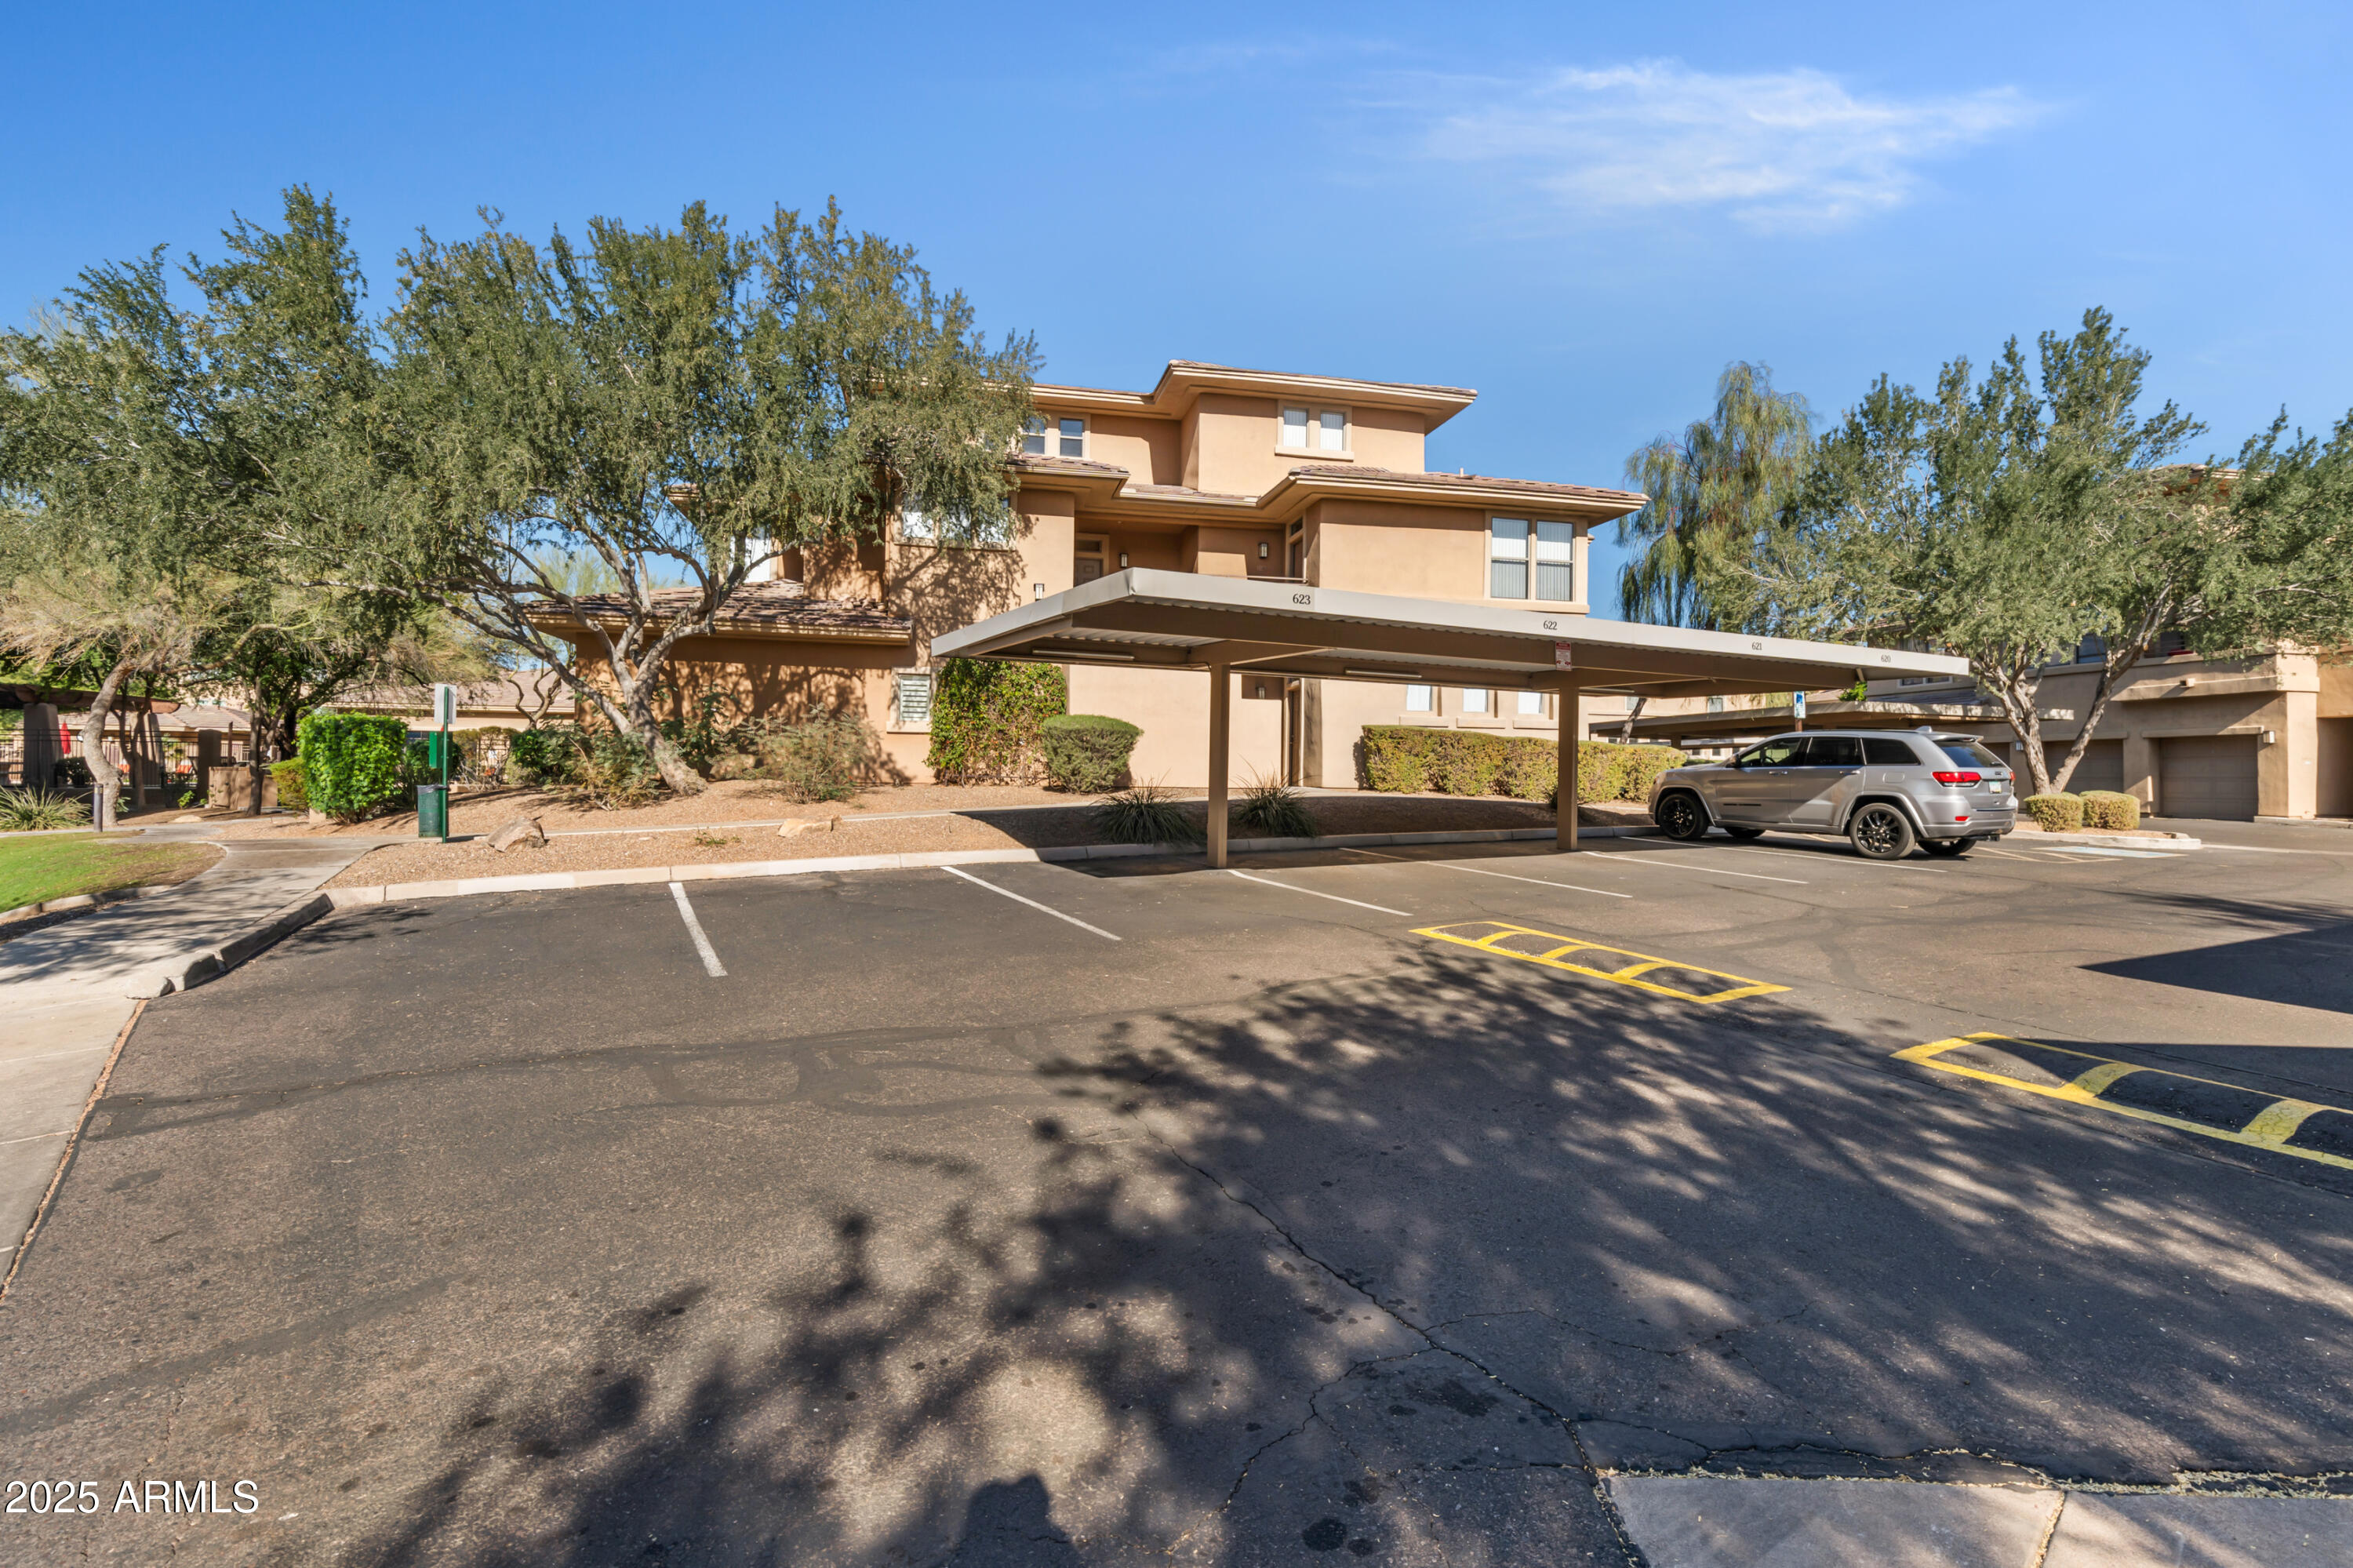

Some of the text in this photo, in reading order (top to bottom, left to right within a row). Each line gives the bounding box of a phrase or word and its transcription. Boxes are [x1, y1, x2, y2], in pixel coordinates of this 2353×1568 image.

[1293, 593, 1311, 605] 623
[1543, 620, 1558, 631] 622
[1751, 641, 1762, 650] 621
[1881, 654, 1892, 664] 620
